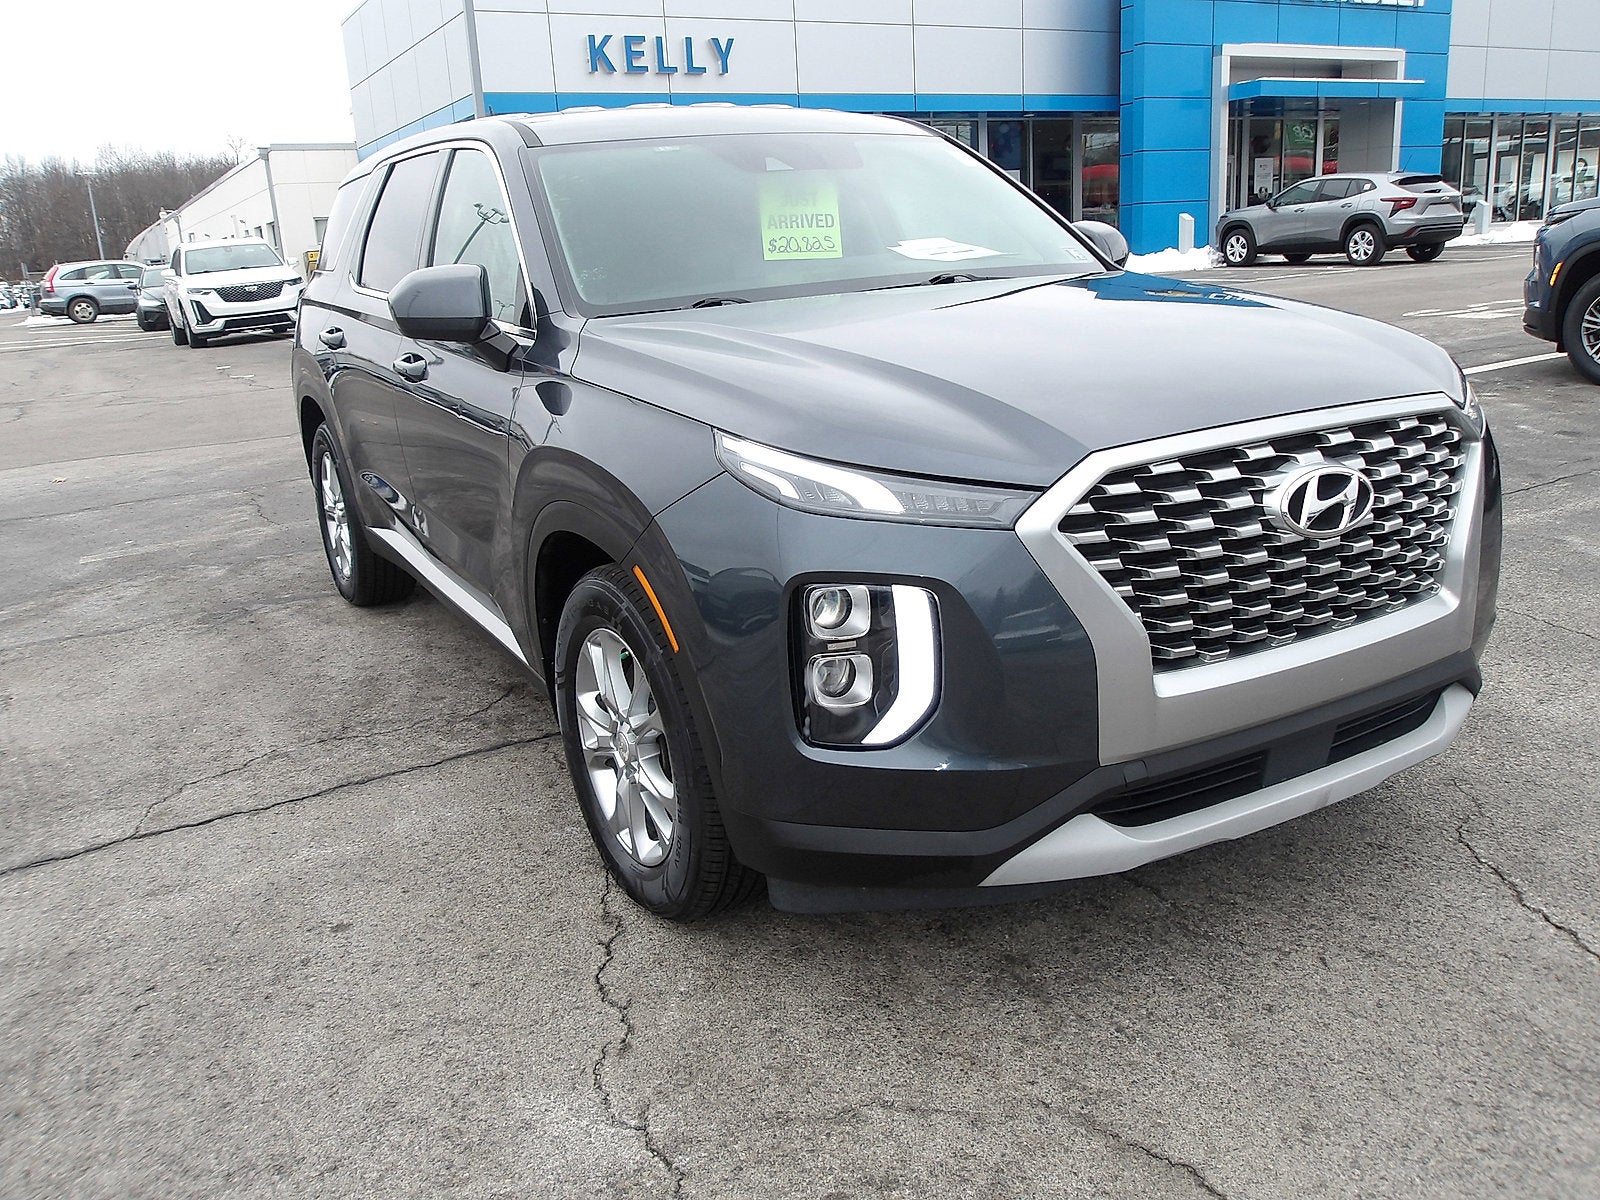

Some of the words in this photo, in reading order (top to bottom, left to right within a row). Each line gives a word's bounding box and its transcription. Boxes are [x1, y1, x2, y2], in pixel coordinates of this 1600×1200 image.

[586, 34, 734, 75] KELLY
[767, 213, 835, 229] ARRIVED
[768, 235, 837, 253] $20,825
